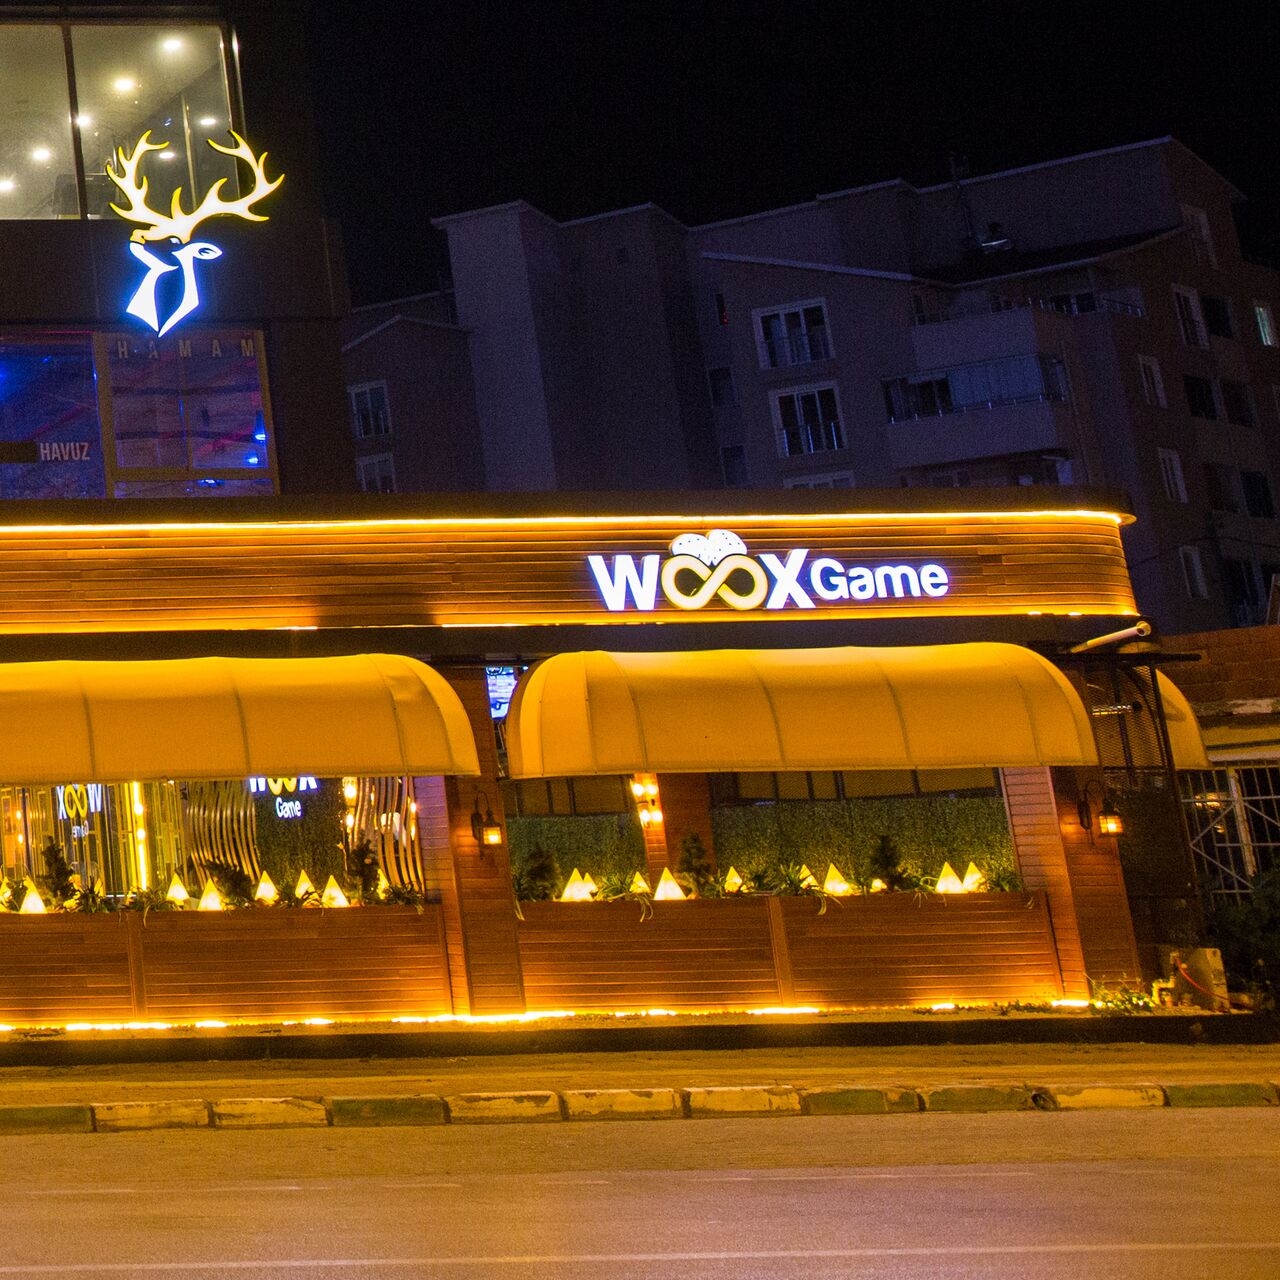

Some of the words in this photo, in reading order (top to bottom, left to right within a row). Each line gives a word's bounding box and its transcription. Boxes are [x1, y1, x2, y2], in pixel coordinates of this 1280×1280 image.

[117, 338, 255, 360] HAMAM
[38, 441, 91, 462] HAVUZ
[810, 557, 950, 601] Game
[275, 796, 302, 819] Game
